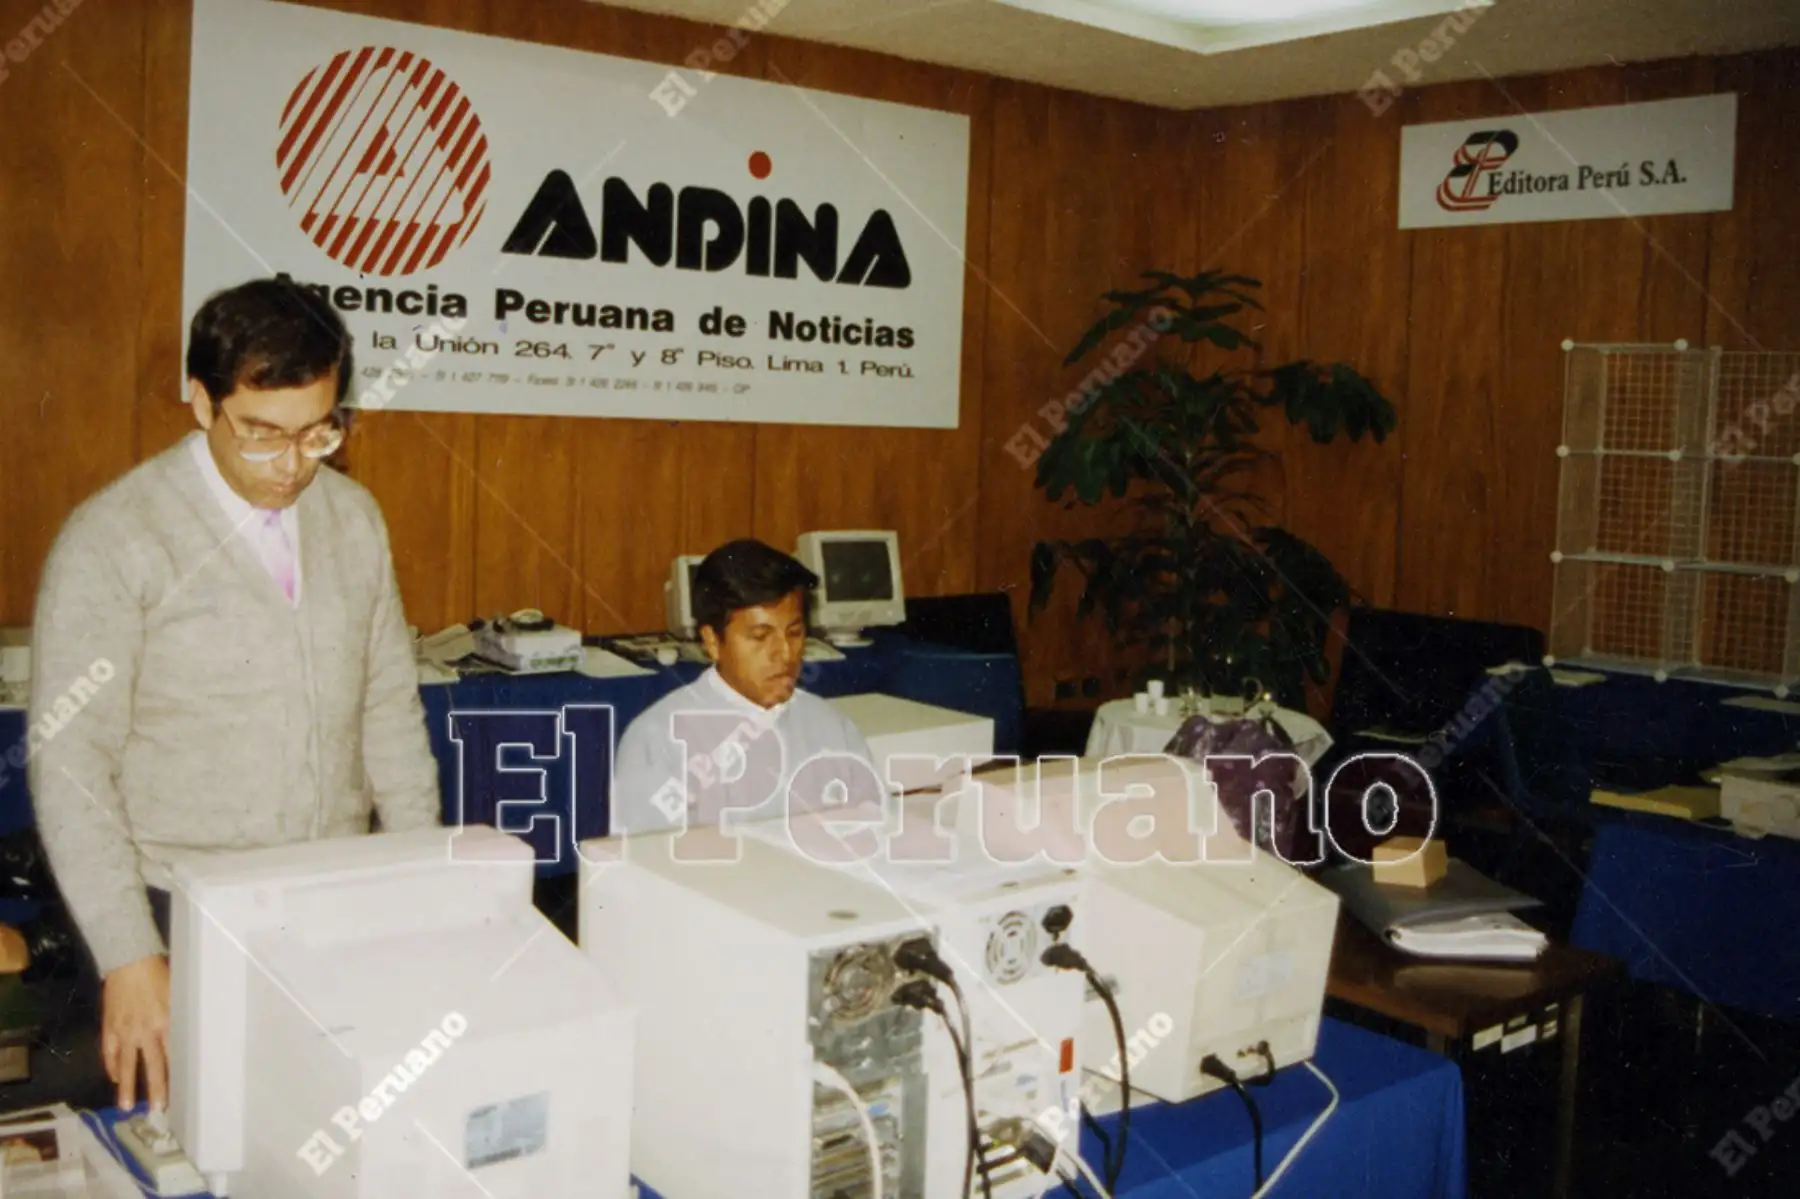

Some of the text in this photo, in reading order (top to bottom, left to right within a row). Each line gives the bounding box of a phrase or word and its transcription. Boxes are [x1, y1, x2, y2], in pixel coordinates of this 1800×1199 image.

[1487, 159, 1687, 196] Editora Perú S.A.
[290, 280, 915, 349] encia Peruana de Noticias
[373, 331, 396, 350] la
[415, 334, 498, 355] Unión
[630, 350, 646, 367] y
[767, 354, 824, 373] Lima
